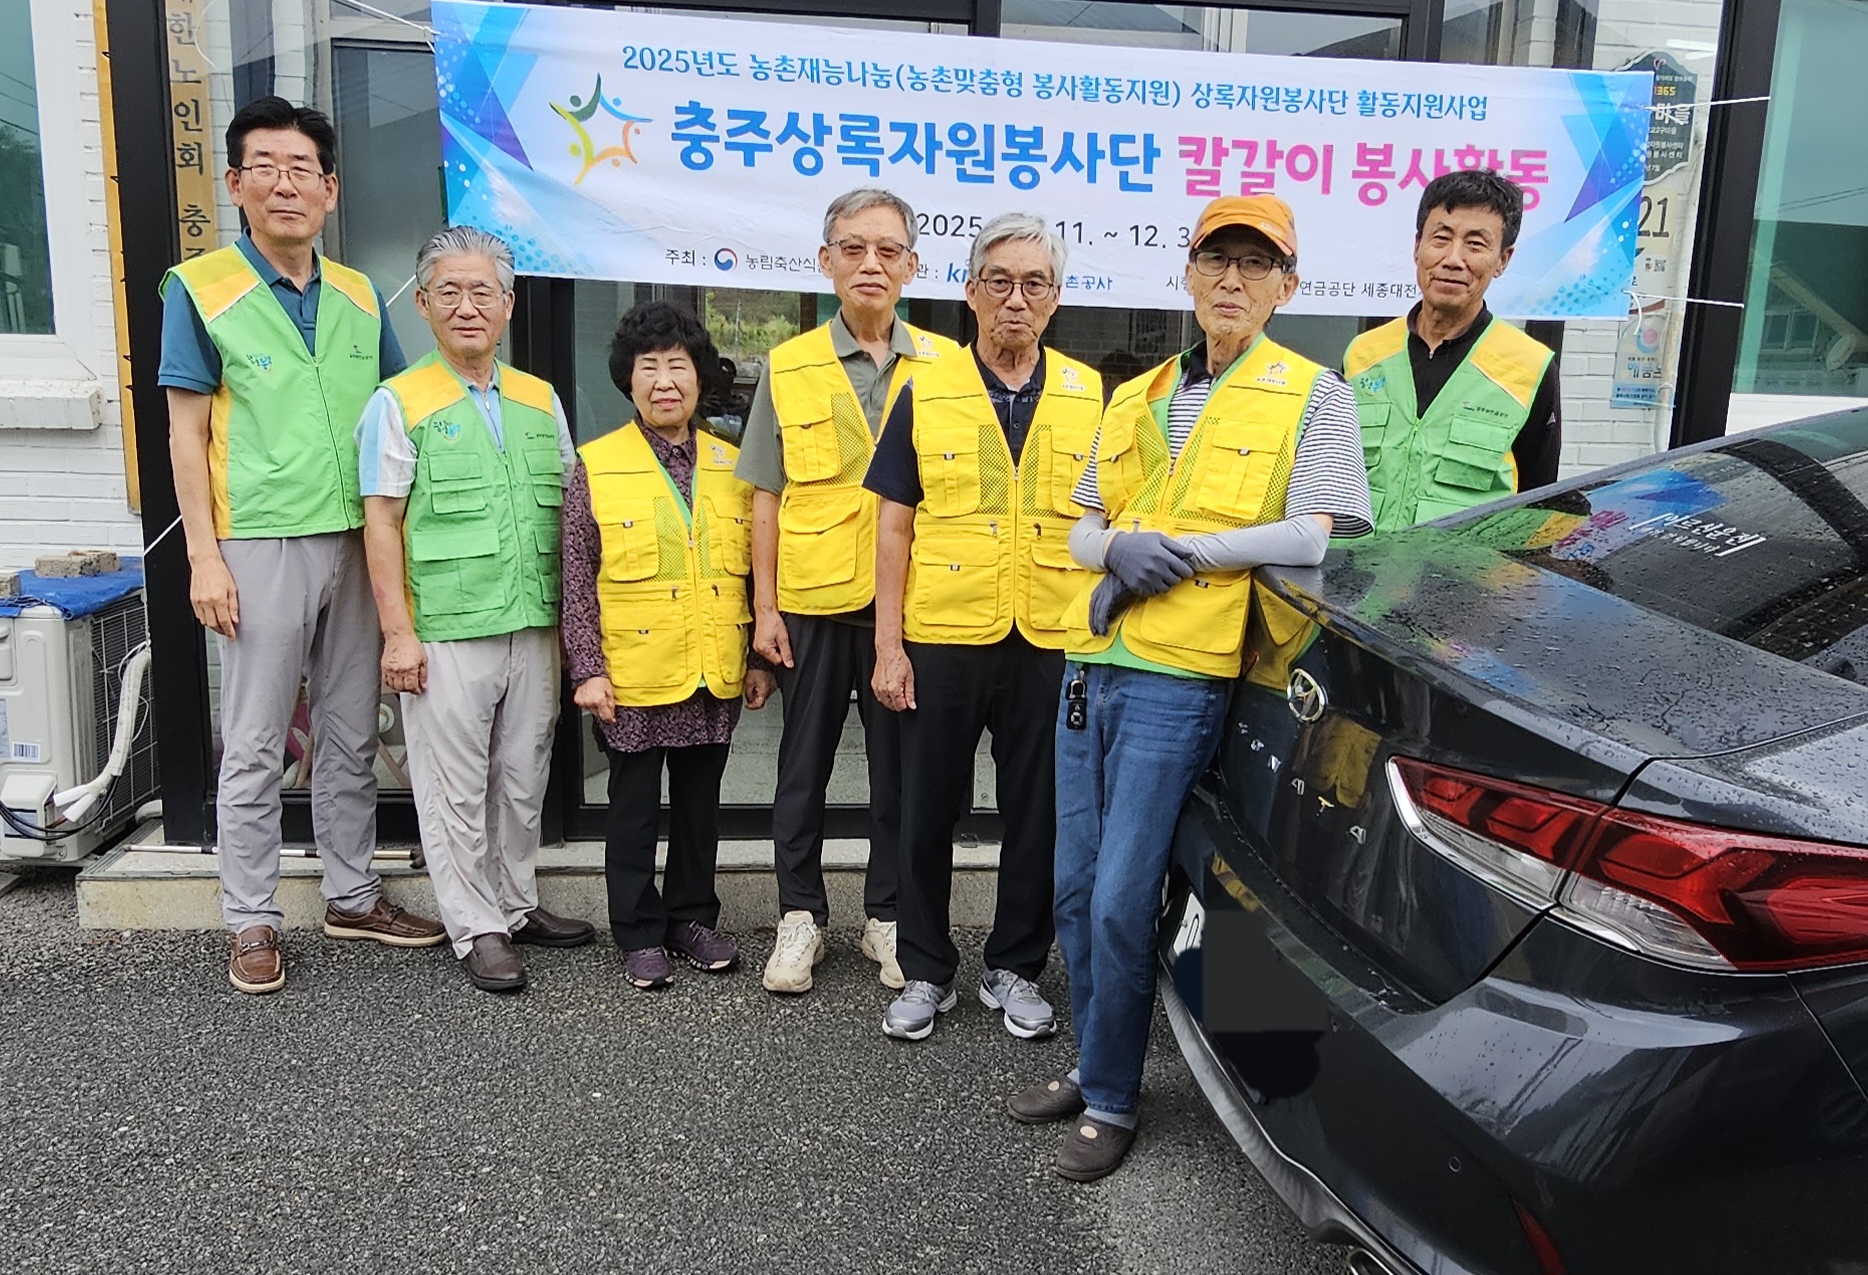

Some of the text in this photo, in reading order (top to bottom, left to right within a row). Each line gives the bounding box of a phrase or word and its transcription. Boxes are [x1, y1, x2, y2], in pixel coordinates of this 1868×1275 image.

[622, 45, 1488, 121] 2025년도 농촌재능나눔(농촌맞춤형 봉사활동지원) 상록자원봉사단 활동지원사업
[671, 100, 1161, 193] 충주상록자원봉사단
[1177, 135, 1334, 198] 칼갈이
[916, 212, 983, 238] 2025
[1129, 224, 1166, 249] 12.
[665, 248, 696, 267] 주최
[745, 253, 823, 273] 농림축산식
[1361, 282, 1423, 299] 세종대전
